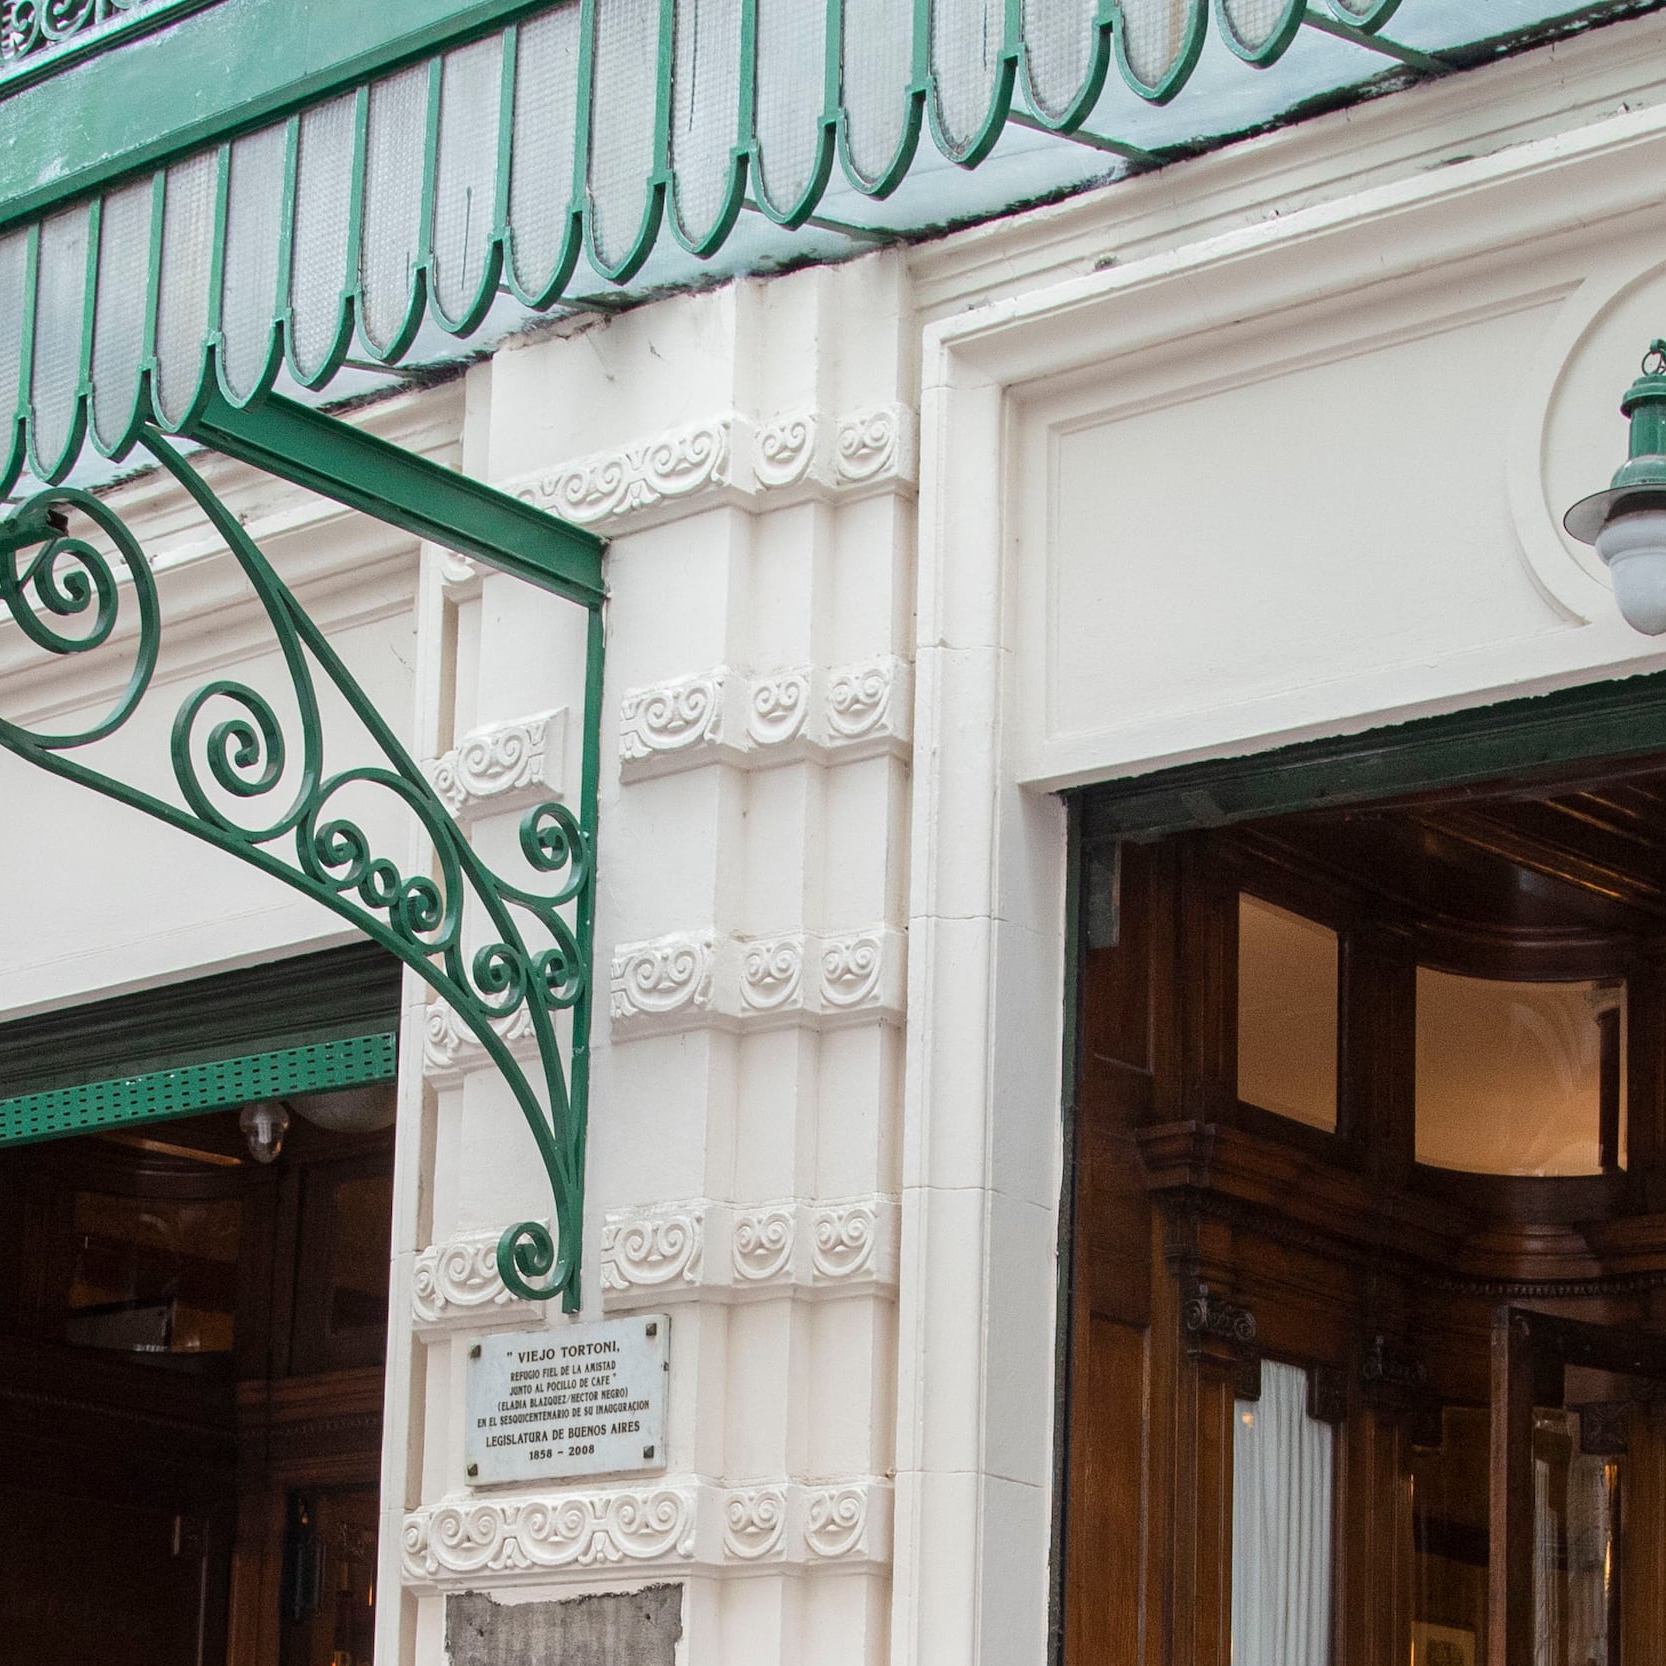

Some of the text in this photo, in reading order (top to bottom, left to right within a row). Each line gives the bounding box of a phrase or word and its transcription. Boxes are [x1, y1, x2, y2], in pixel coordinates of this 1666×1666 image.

[518, 1341, 620, 1363] VIEJO TORTONI,
[511, 1360, 616, 1382] REFUGIO FIEL AMISTAD
[510, 1376, 610, 1396] JUNTO POCILLO CAFE
[498, 1400, 527, 1412] (ELADIA
[601, 1387, 628, 1399] NEGRO)
[500, 1400, 649, 1426] SESQUICENTENARIO INAUGURACION
[486, 1421, 640, 1448] LEGISLATURA DE BUENOS AIRES
[529, 1445, 595, 1460] 1858 2008
